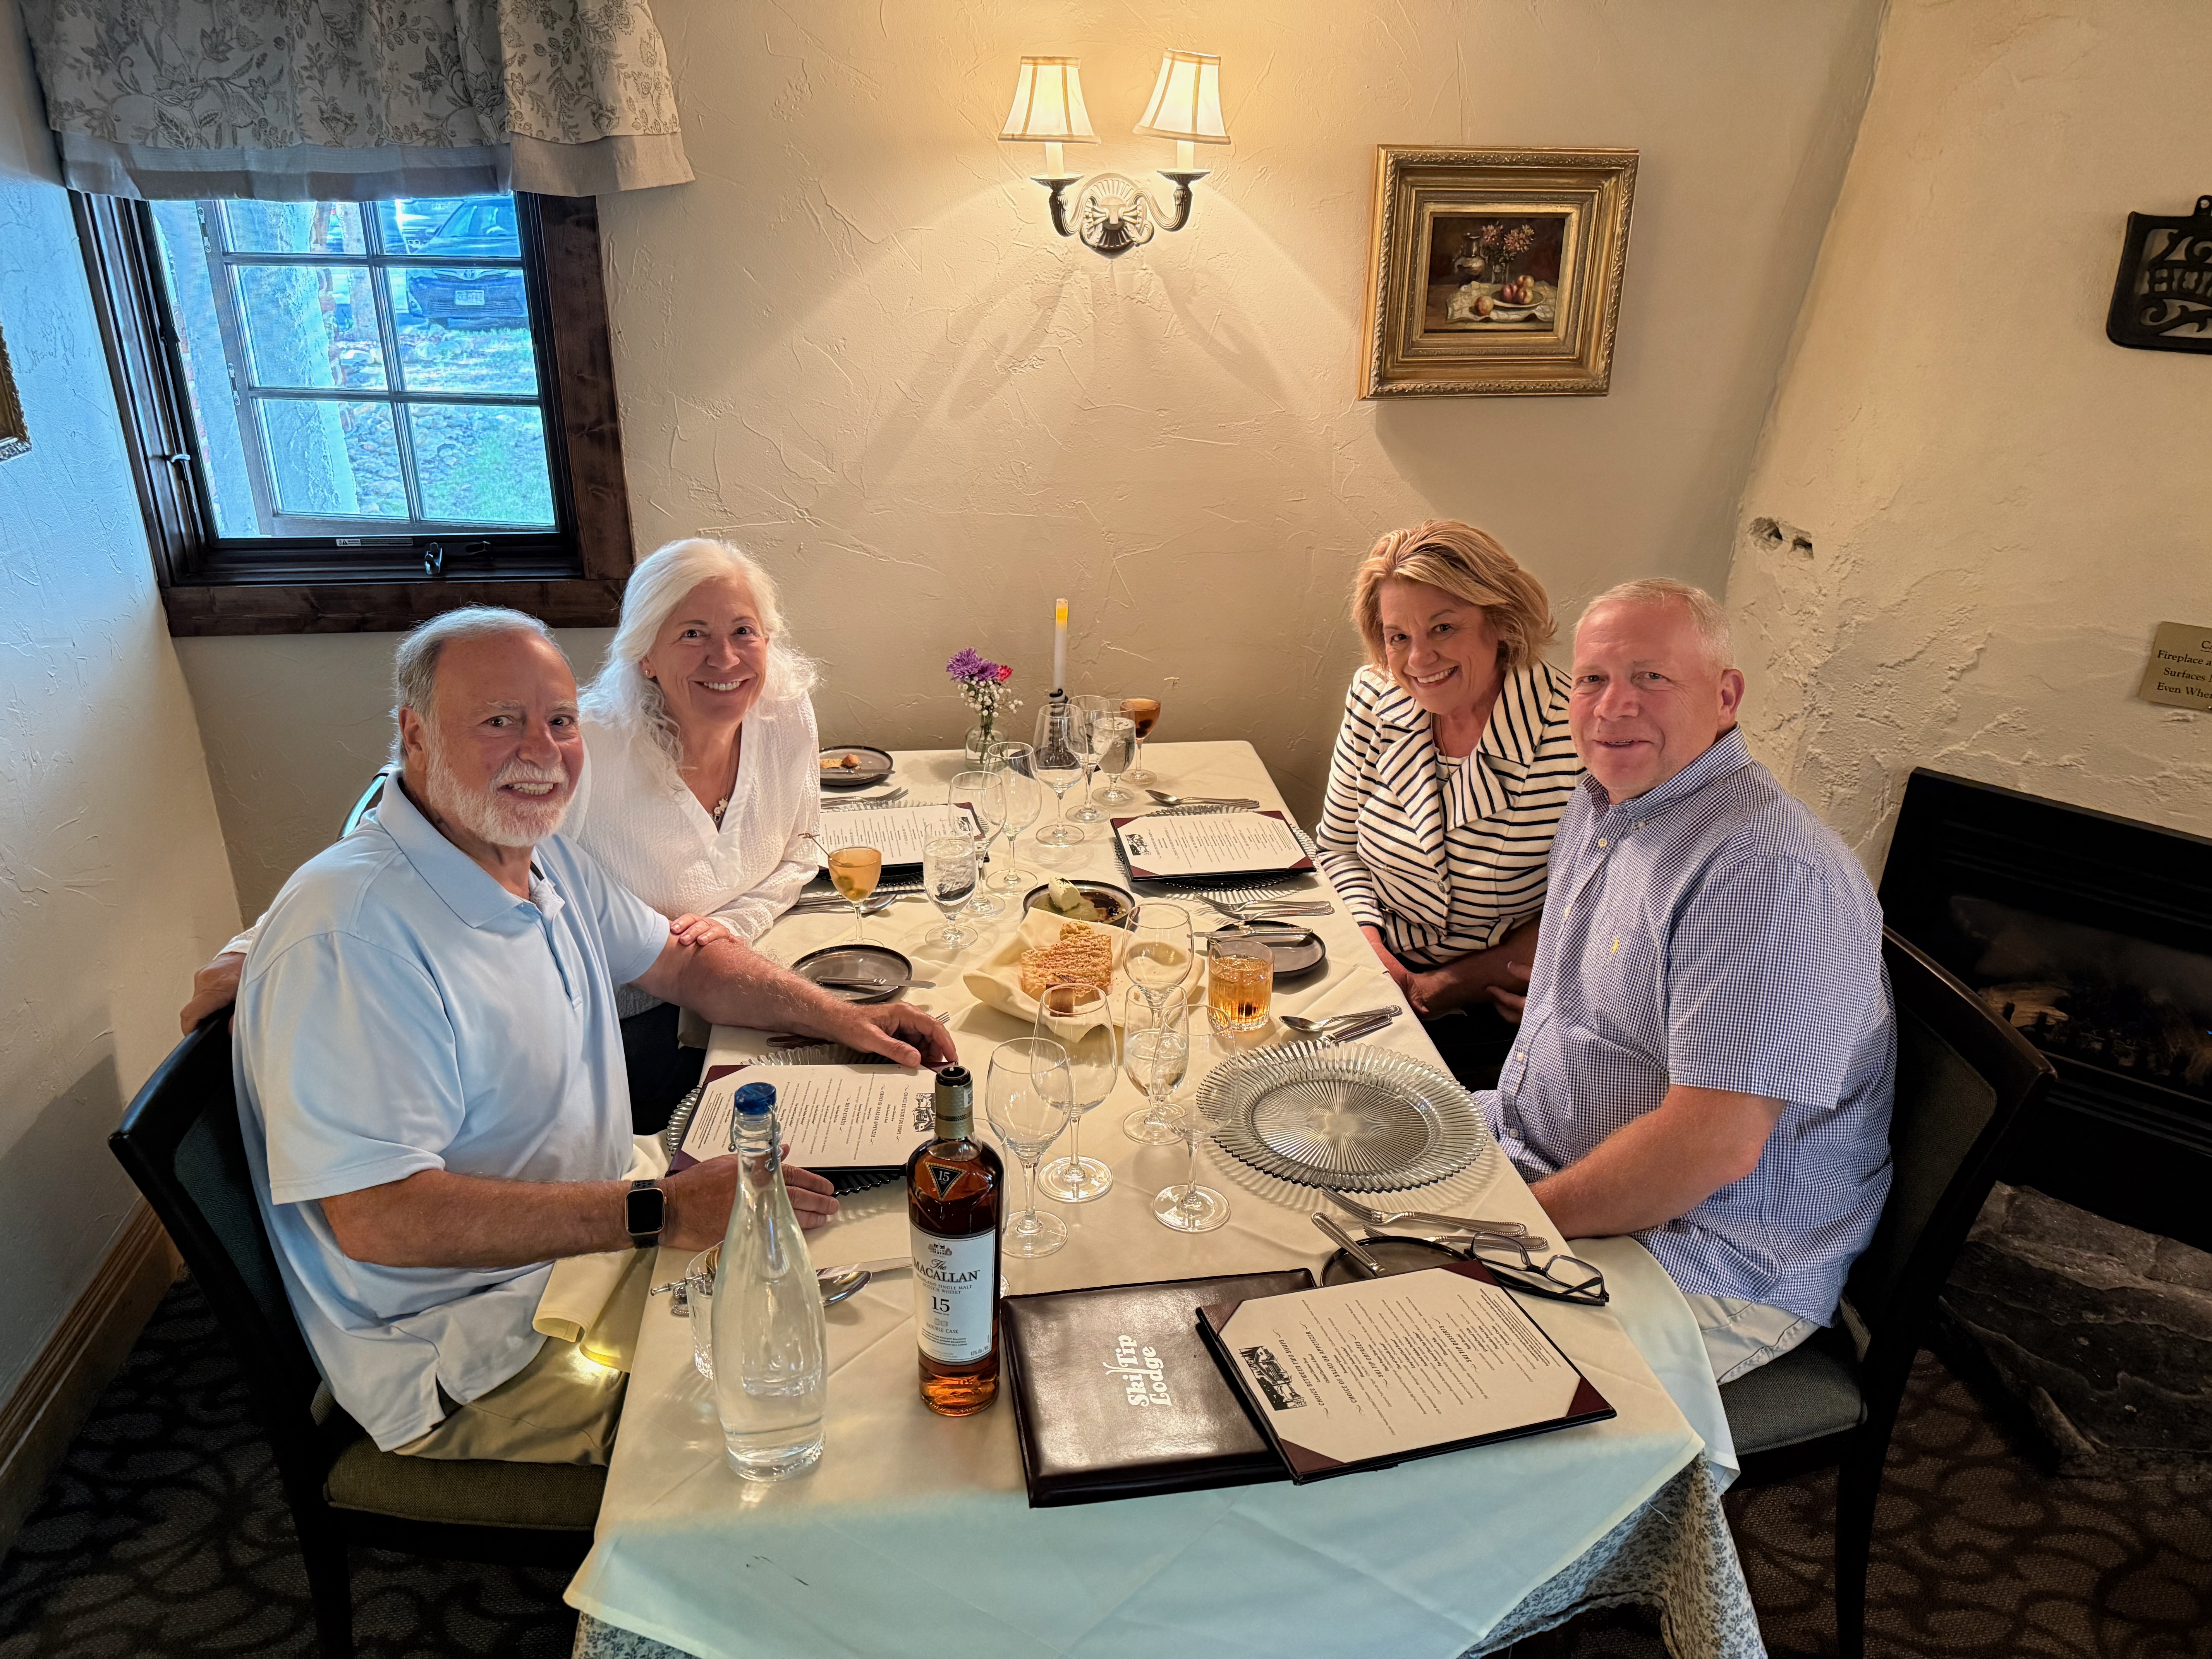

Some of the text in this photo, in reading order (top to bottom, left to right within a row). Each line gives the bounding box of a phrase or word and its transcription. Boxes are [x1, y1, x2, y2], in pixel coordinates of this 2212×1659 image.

[2158, 650, 2203, 665] Fireplace
[2164, 667, 2205, 681] Surfaces
[2157, 682, 2181, 694] Even
[938, 1171, 950, 1182] 15
[914, 1256, 981, 1283] MACALLAN
[930, 1259, 947, 1270] The
[923, 1282, 940, 1292] SCOTCH
[931, 1296, 950, 1312] 15
[926, 1322, 944, 1333] DOUBLE
[1439, 1326, 1459, 1345] DESSERTS
[1305, 1331, 1325, 1354] APPETIZER
[1354, 1341, 1371, 1360] ENTRÉES
[1143, 1346, 1173, 1407] Lodge
[1278, 1340, 1324, 1406] CHOICE BETWEEN TWO SOUPS
[1326, 1363, 1340, 1377] SALAD
[1123, 1374, 1150, 1407] Ski
[1341, 1385, 1357, 1403] CHOICE
